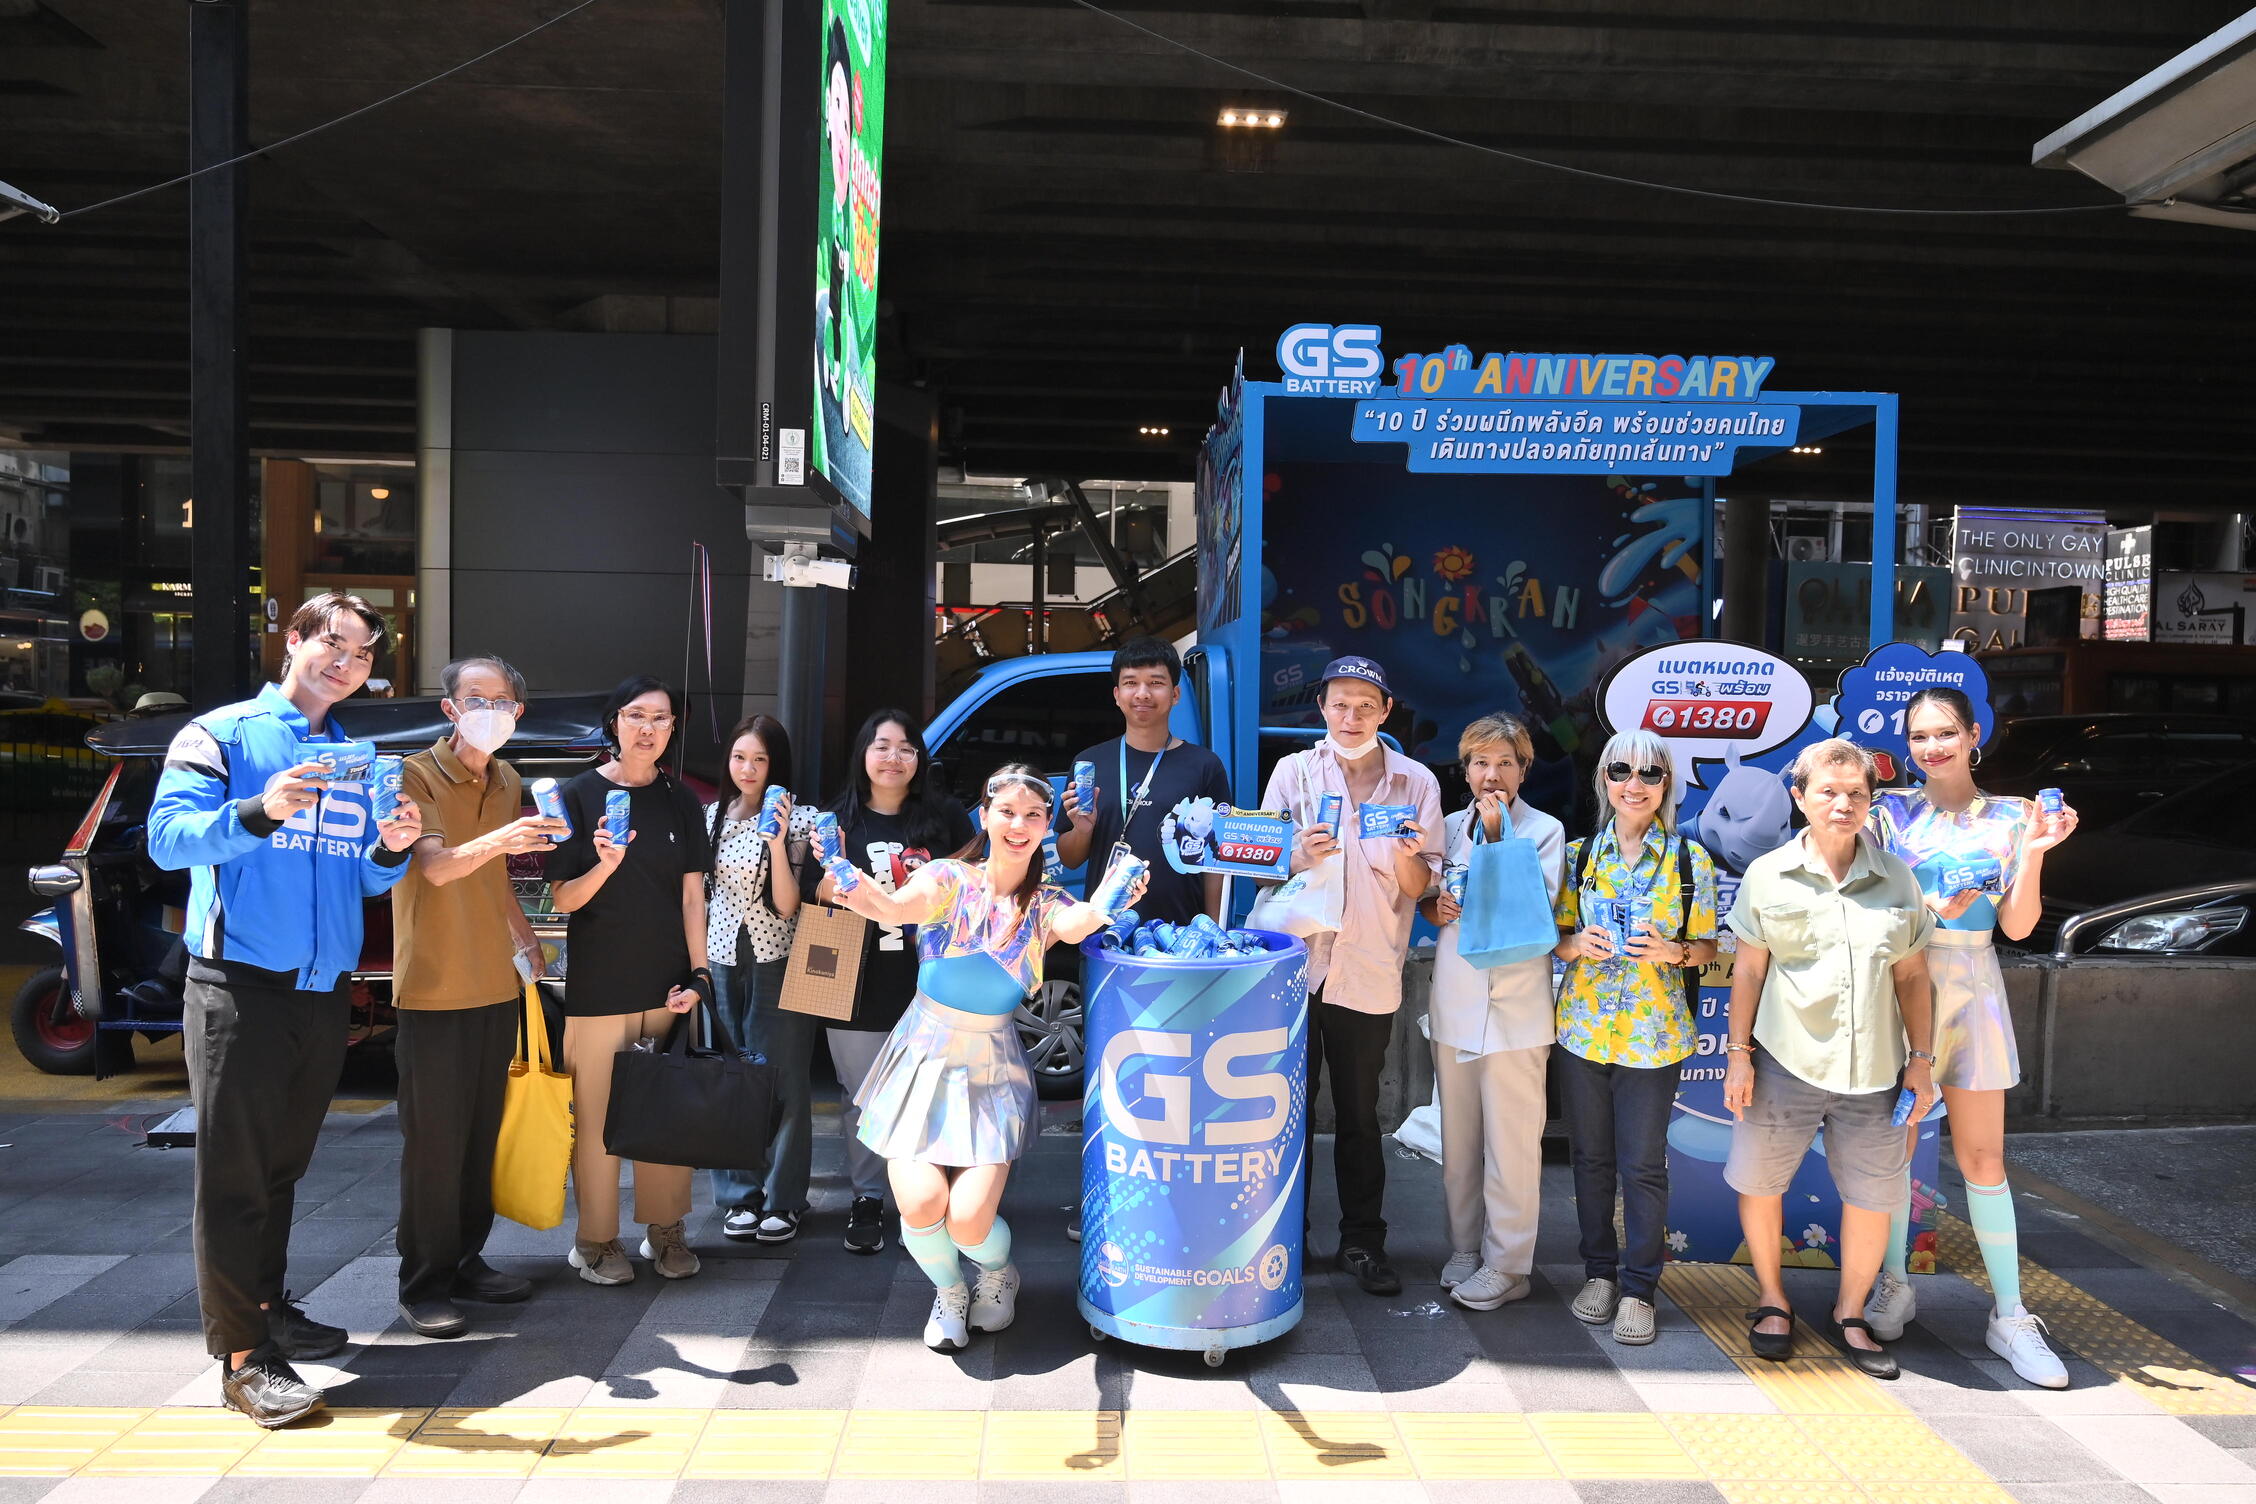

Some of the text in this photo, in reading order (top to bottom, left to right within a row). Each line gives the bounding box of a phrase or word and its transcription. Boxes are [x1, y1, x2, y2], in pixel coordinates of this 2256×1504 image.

[1281, 328, 1380, 377] GS
[1399, 349, 1769, 397] 10th ANNIVERSARY
[1287, 378, 1376, 394] BATTERY
[1411, 408, 1428, 431] ปี
[1435, 408, 1603, 433] ร่วมผนึกพลังอึด
[1613, 410, 1785, 435] พร้อมช่วยคนไทย
[762, 402, 770, 461] CRM-01-04-021
[1961, 530, 2103, 552] THE ONLY GAY
[1958, 557, 2106, 580] CLINIC IN TOWN
[2105, 554, 2151, 571] PULSE
[2105, 567, 2150, 581] CLINIC
[162, 583, 192, 591] KARM
[1338, 577, 1580, 637] SONGKRAN
[2177, 621, 2225, 632] SARAY
[1273, 663, 1304, 686] GS
[1338, 664, 1382, 683] CROWN
[1658, 660, 1775, 676] แบตหมดกด
[1874, 666, 1964, 688] แจ้งอุบัติเหตุ
[1651, 680, 1680, 694] GS
[1719, 679, 1771, 696] พร้อม
[1679, 706, 1757, 730] 1380
[1224, 821, 1283, 835] แบตหมดกด
[1364, 810, 1390, 828] GS
[271, 832, 362, 858] BATTERY
[1223, 831, 1238, 840] GS
[1235, 847, 1275, 862] 1380
[1943, 866, 1975, 885] GS
[1101, 1026, 1291, 1146] GS
[1105, 1142, 1289, 1184] BATTERY
[1134, 1263, 1193, 1279] SUSTAINABLE
[1134, 1273, 1193, 1287] DEVELOPMENT
[1193, 1265, 1255, 1287] GOALS
